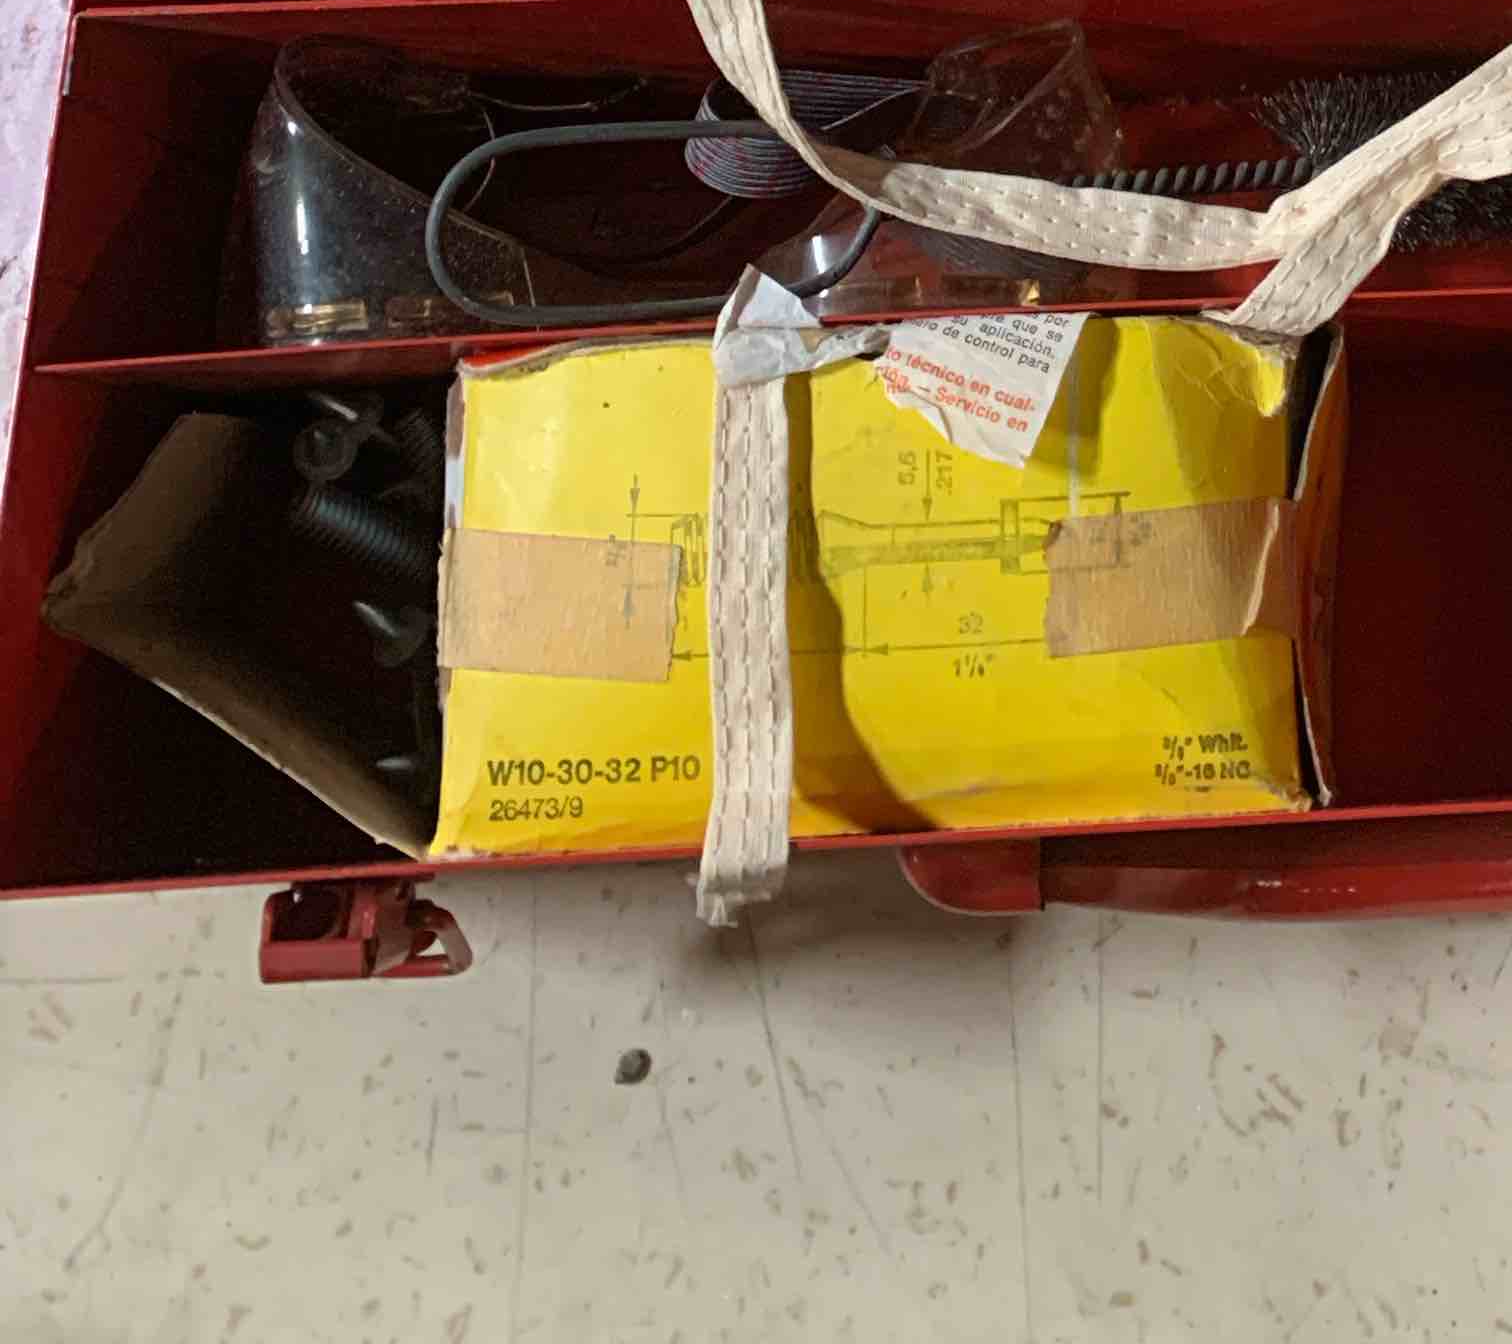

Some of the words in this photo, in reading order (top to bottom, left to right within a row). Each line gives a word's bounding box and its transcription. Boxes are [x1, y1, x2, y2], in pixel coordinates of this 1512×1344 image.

[1012, 318, 1038, 335] que
[1046, 329, 1064, 343] se
[942, 326, 960, 339] de
[965, 333, 1014, 359] control
[1018, 353, 1050, 373] para
[970, 380, 990, 395] en
[936, 387, 1001, 423] Servicio
[1008, 416, 1028, 433] en
[488, 757, 641, 786] W10-30-32
[651, 755, 701, 782] P10
[489, 795, 583, 821] 26473/9
